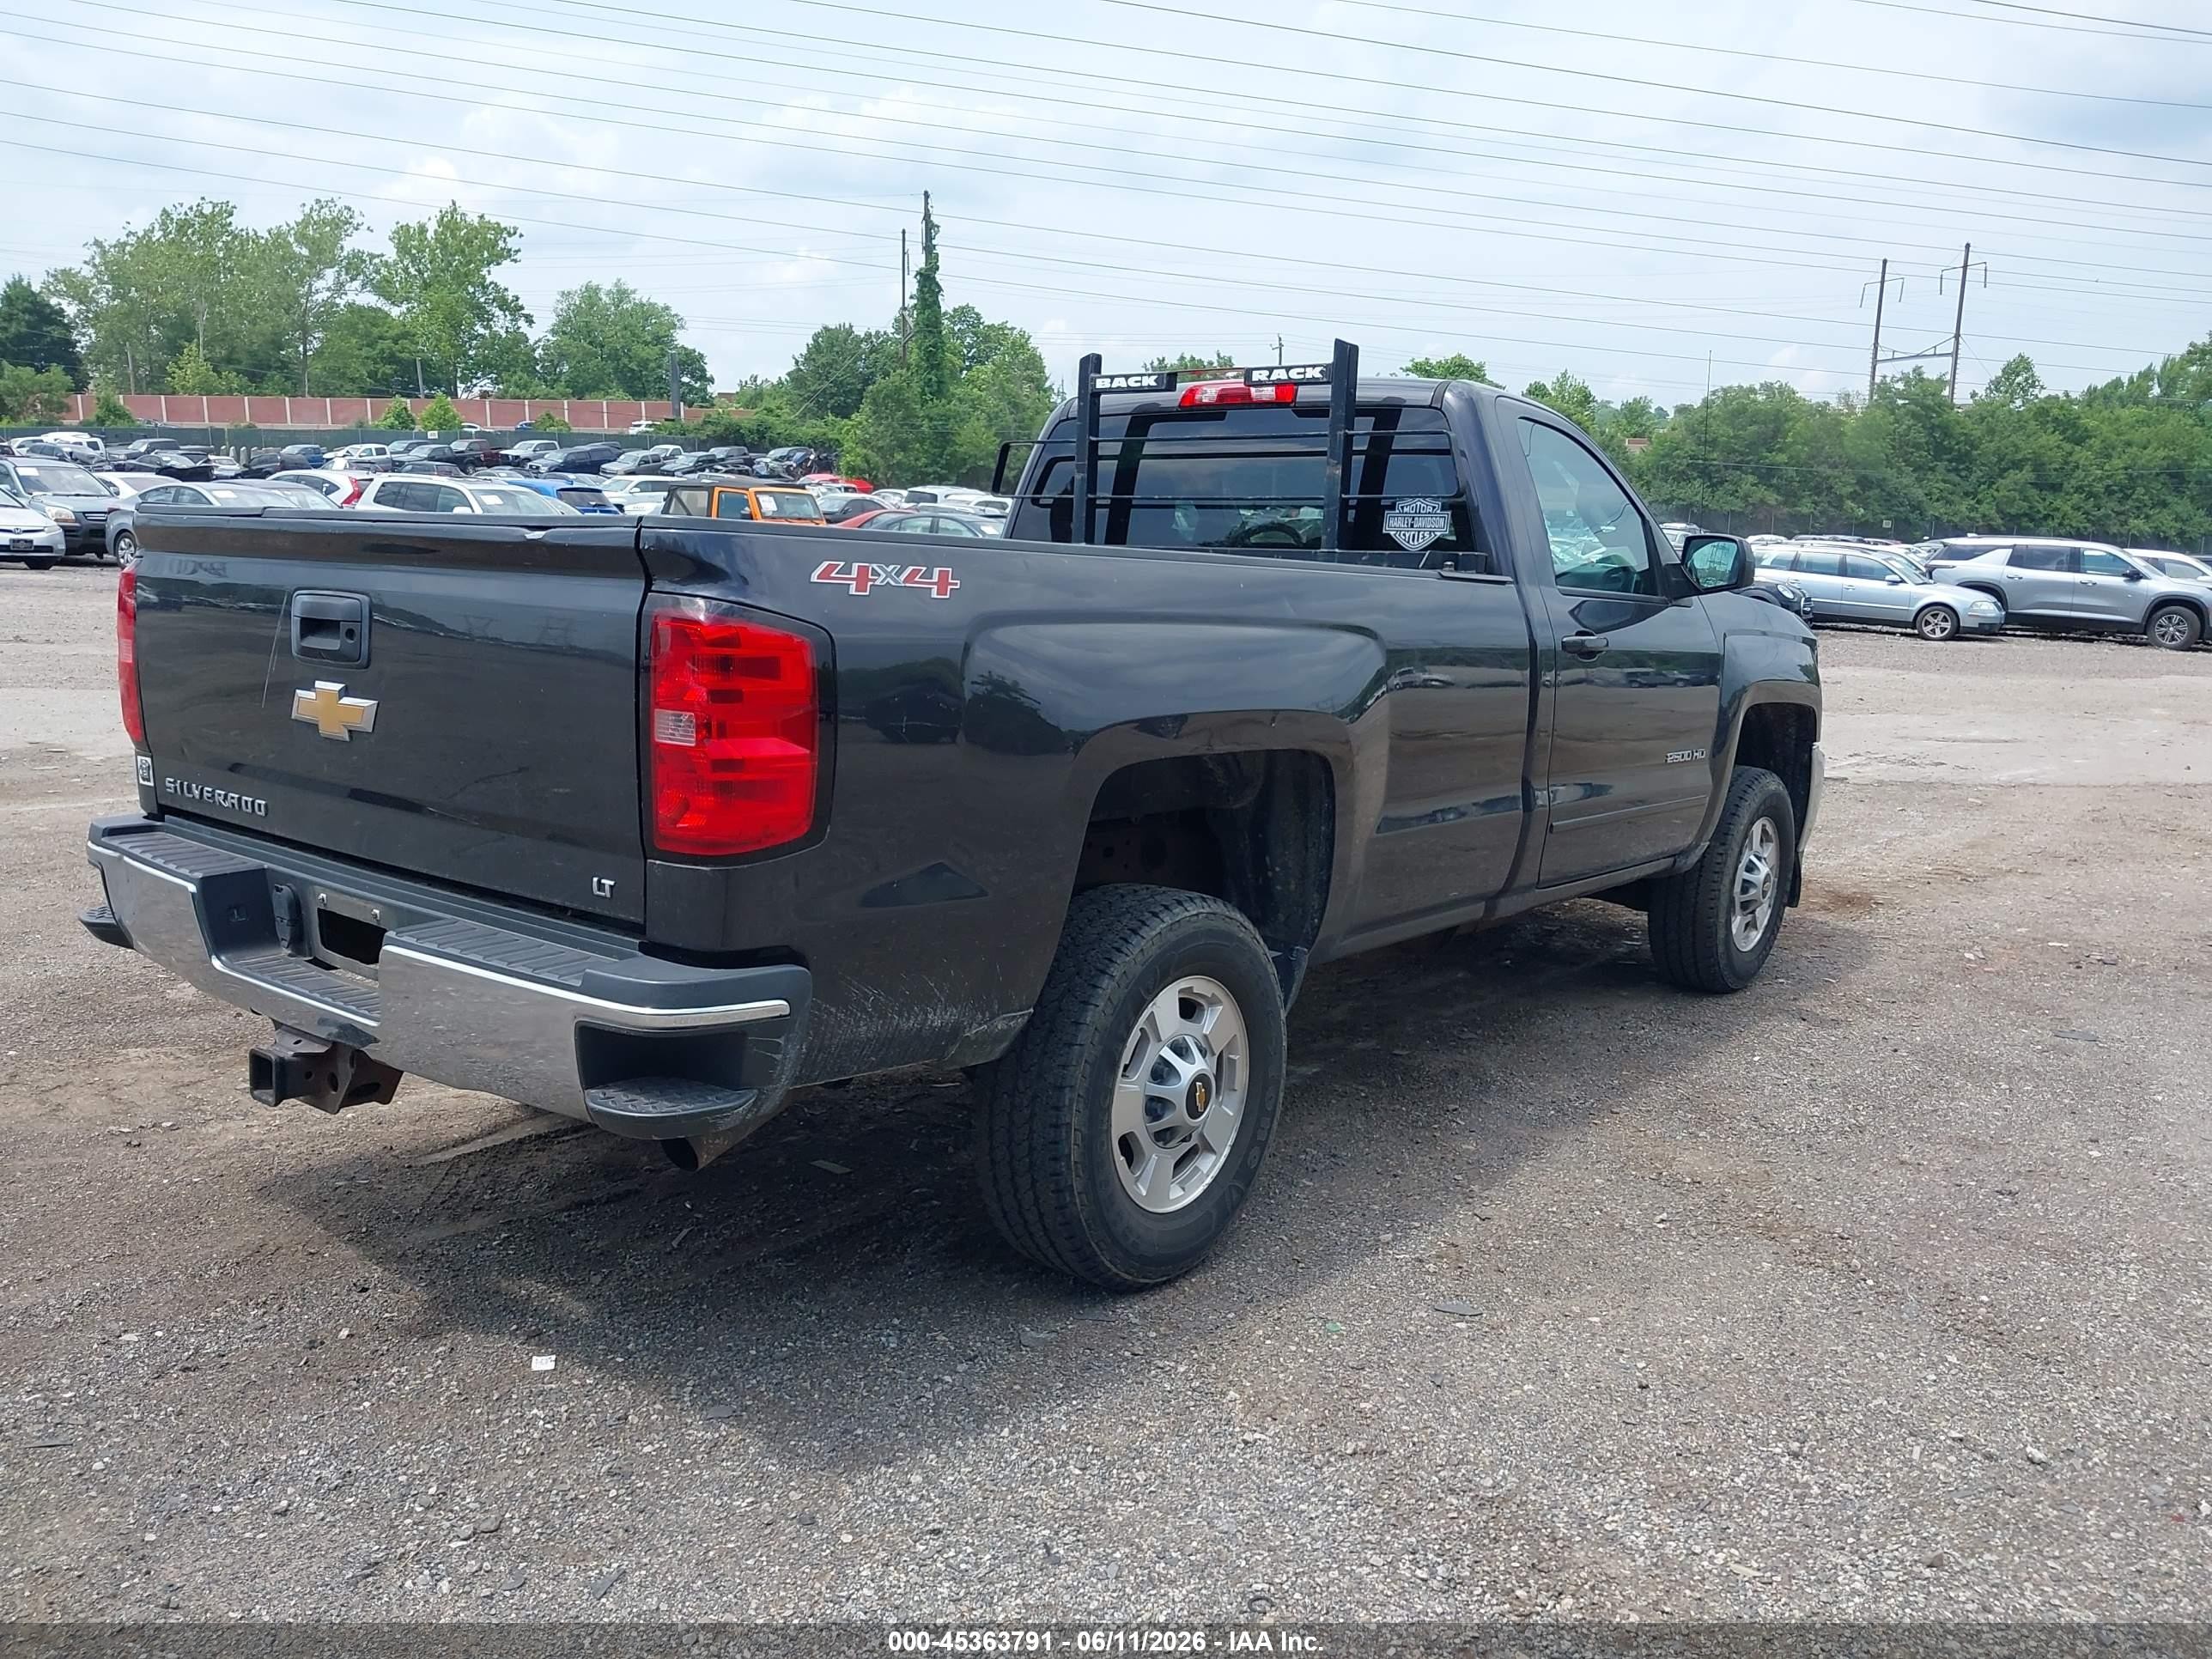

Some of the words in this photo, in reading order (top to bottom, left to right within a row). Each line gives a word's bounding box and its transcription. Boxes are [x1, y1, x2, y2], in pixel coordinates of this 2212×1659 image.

[1251, 366, 1325, 381] RACK
[1095, 375, 1158, 389] BACK
[1403, 501, 1433, 514] MOTOR
[1389, 516, 1444, 529] HARLEY-DAVIDSON
[1400, 532, 1430, 545] CYCLES
[1667, 750, 1692, 763] 2500
[1692, 748, 1706, 761] HD
[165, 777, 267, 817] SILVERADO
[592, 877, 616, 898] LT
